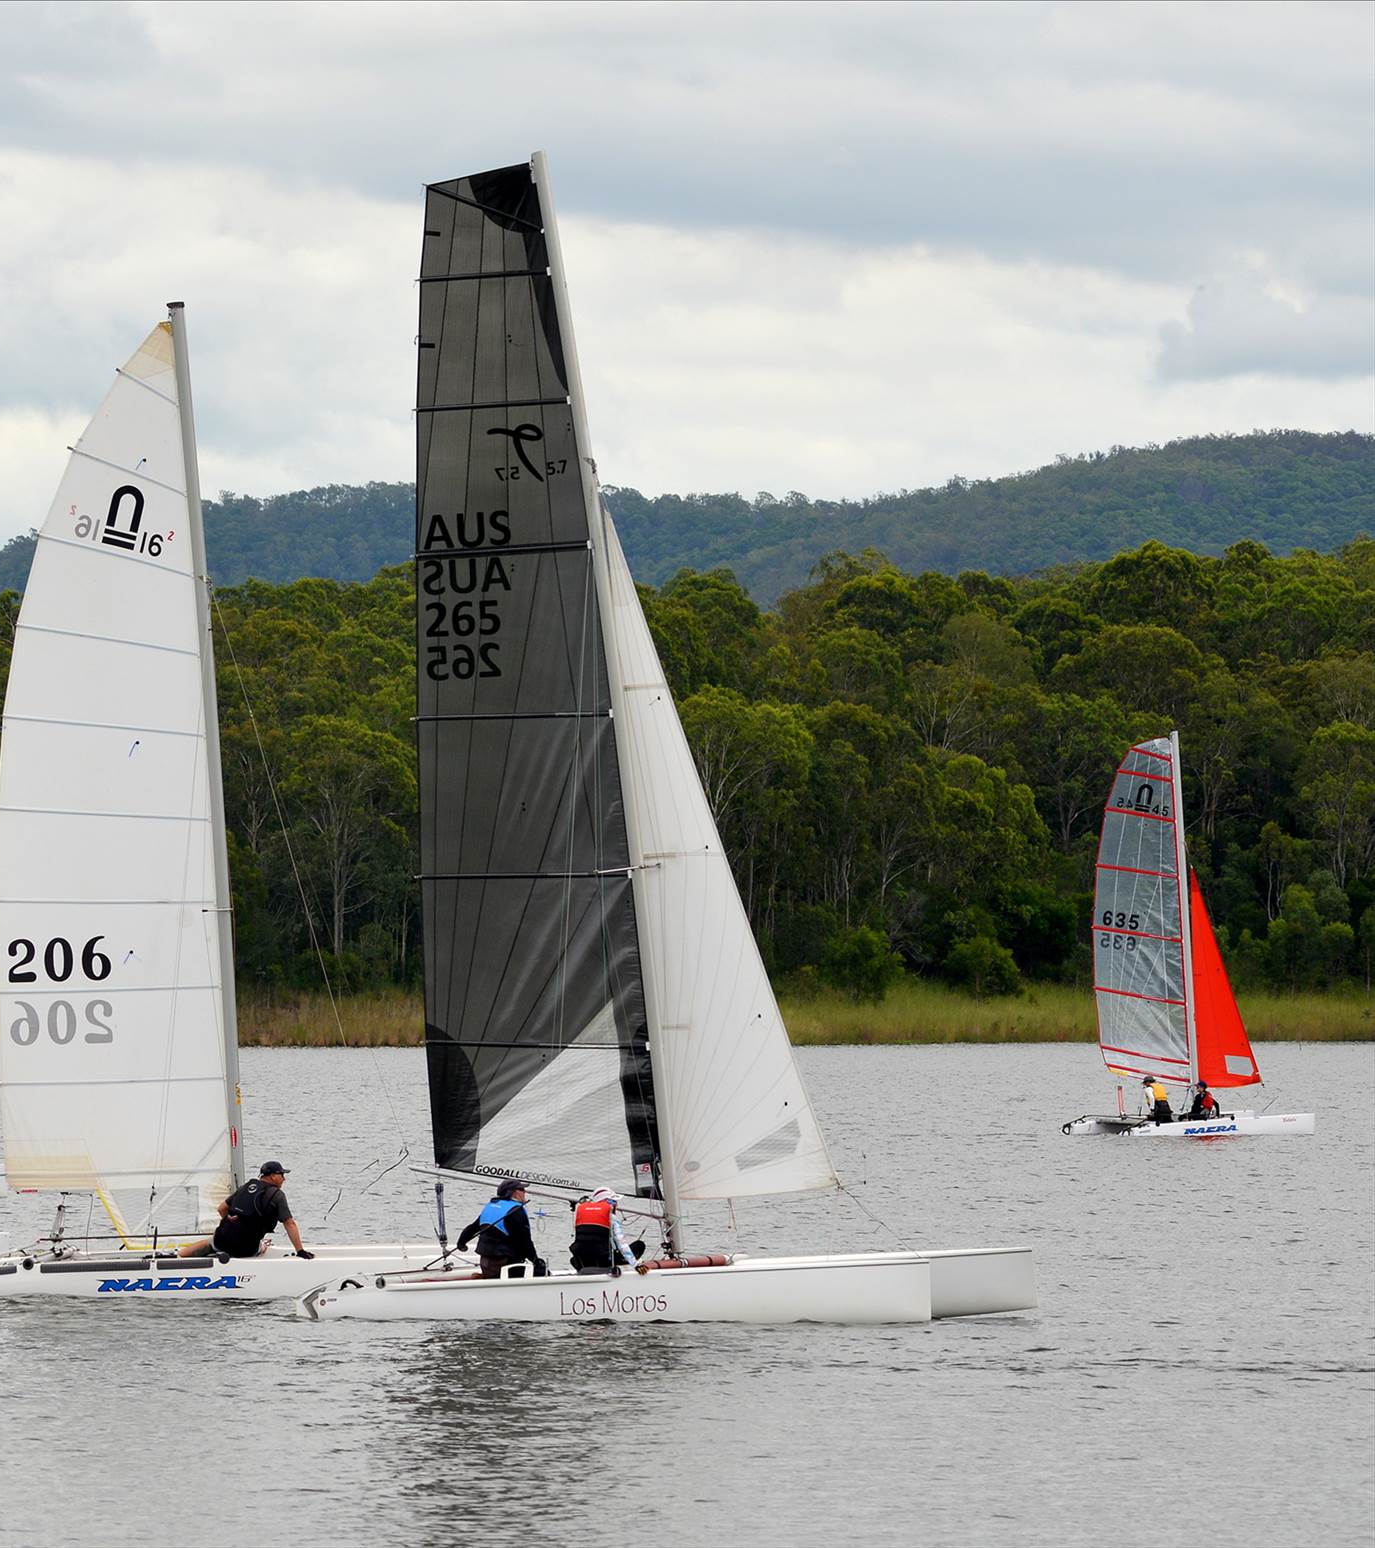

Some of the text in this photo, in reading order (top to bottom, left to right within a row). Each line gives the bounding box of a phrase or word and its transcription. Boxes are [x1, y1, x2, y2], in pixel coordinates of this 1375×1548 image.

[546, 459, 568, 476] 5.7
[424, 510, 512, 550] AUS
[425, 600, 502, 638] 265
[1102, 910, 1140, 931] 635
[7, 935, 112, 984] 206
[560, 1290, 668, 1316] Los Moros
